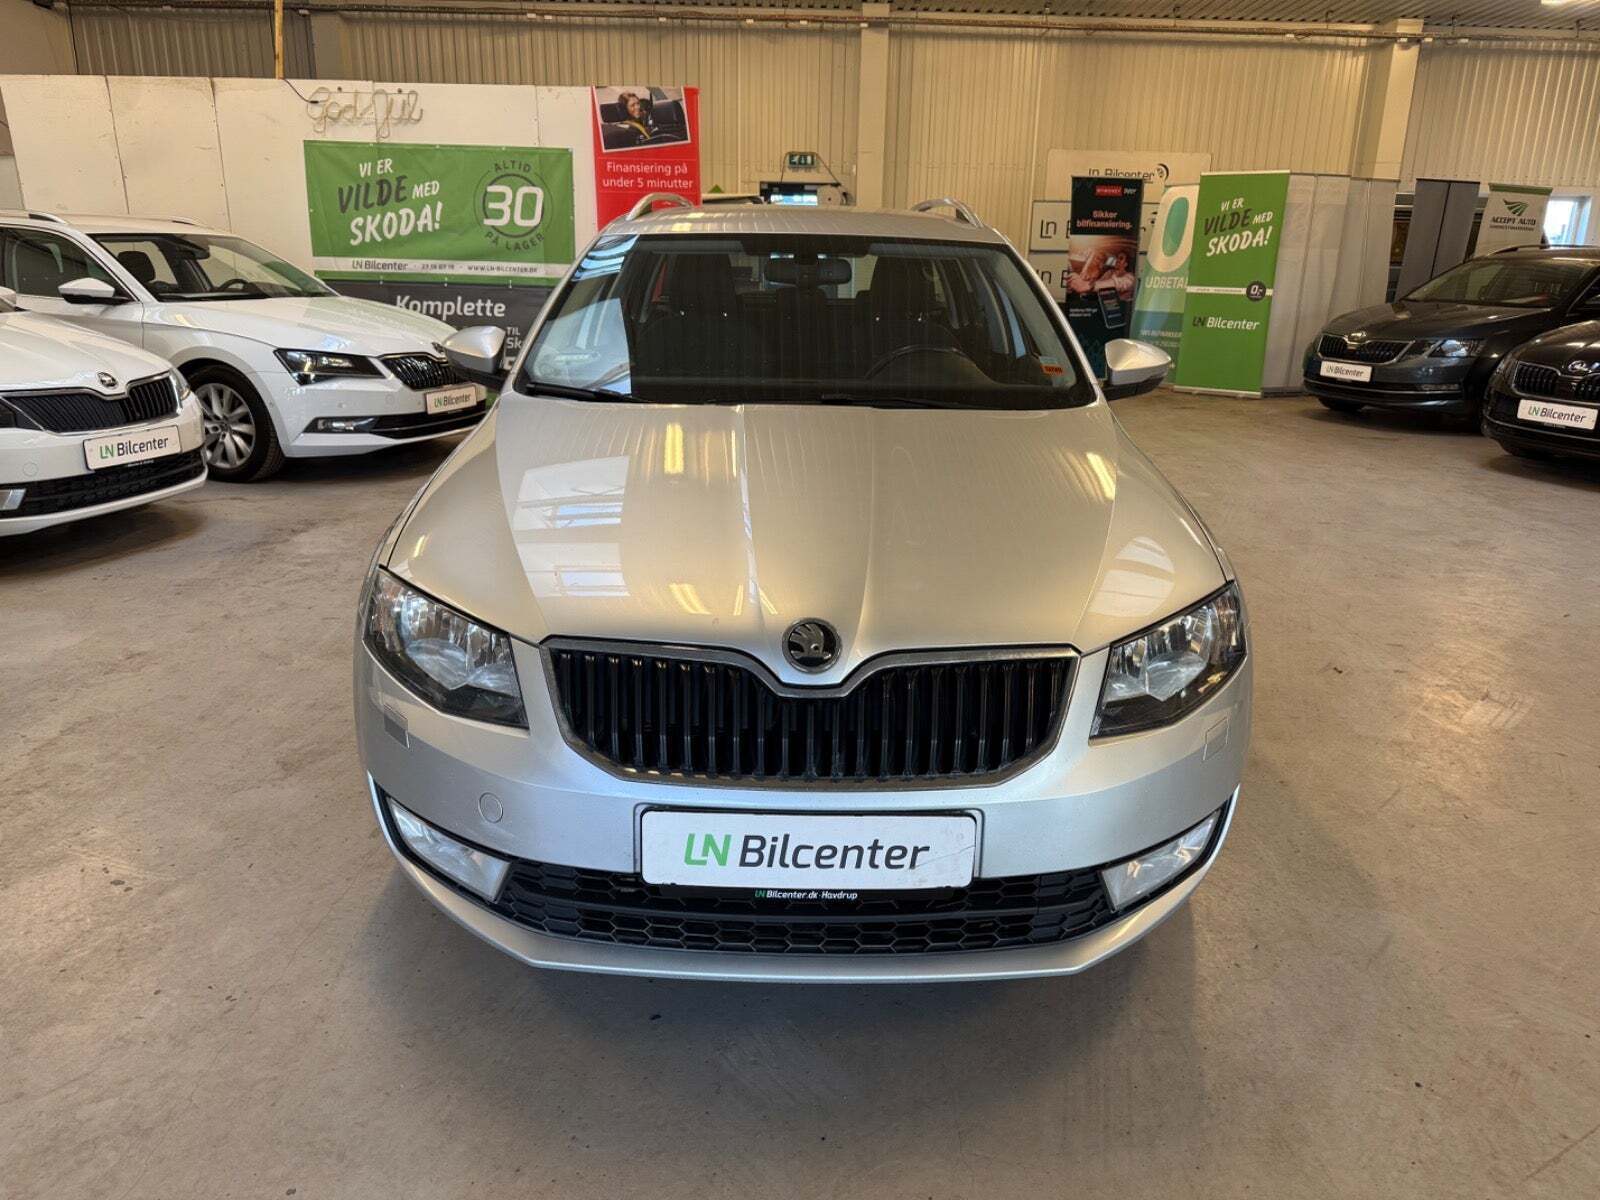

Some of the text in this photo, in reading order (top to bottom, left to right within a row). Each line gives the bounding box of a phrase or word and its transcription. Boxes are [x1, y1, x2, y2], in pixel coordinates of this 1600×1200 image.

[359, 158, 394, 178] VI ER
[494, 159, 532, 173] ALTID
[606, 161, 688, 177] Finansiering på
[602, 177, 694, 189] under 5 minutter
[337, 174, 440, 215] VILDE MED
[483, 185, 544, 227] 30
[1220, 197, 1244, 212] VI ER
[349, 200, 443, 247] SKODA!
[1203, 208, 1274, 236] VILDE MED
[505, 232, 544, 251] LAGER
[1205, 225, 1274, 257] SKODA!
[364, 260, 409, 271] Bilcenter
[396, 295, 507, 321] Komplette
[506, 326, 521, 336] TIL
[1206, 317, 1261, 331] Bilcenter
[1540, 407, 1587, 424] Bilcenter
[100, 437, 169, 459] LN Bilcenter
[684, 832, 931, 871] LN Bilcenter
